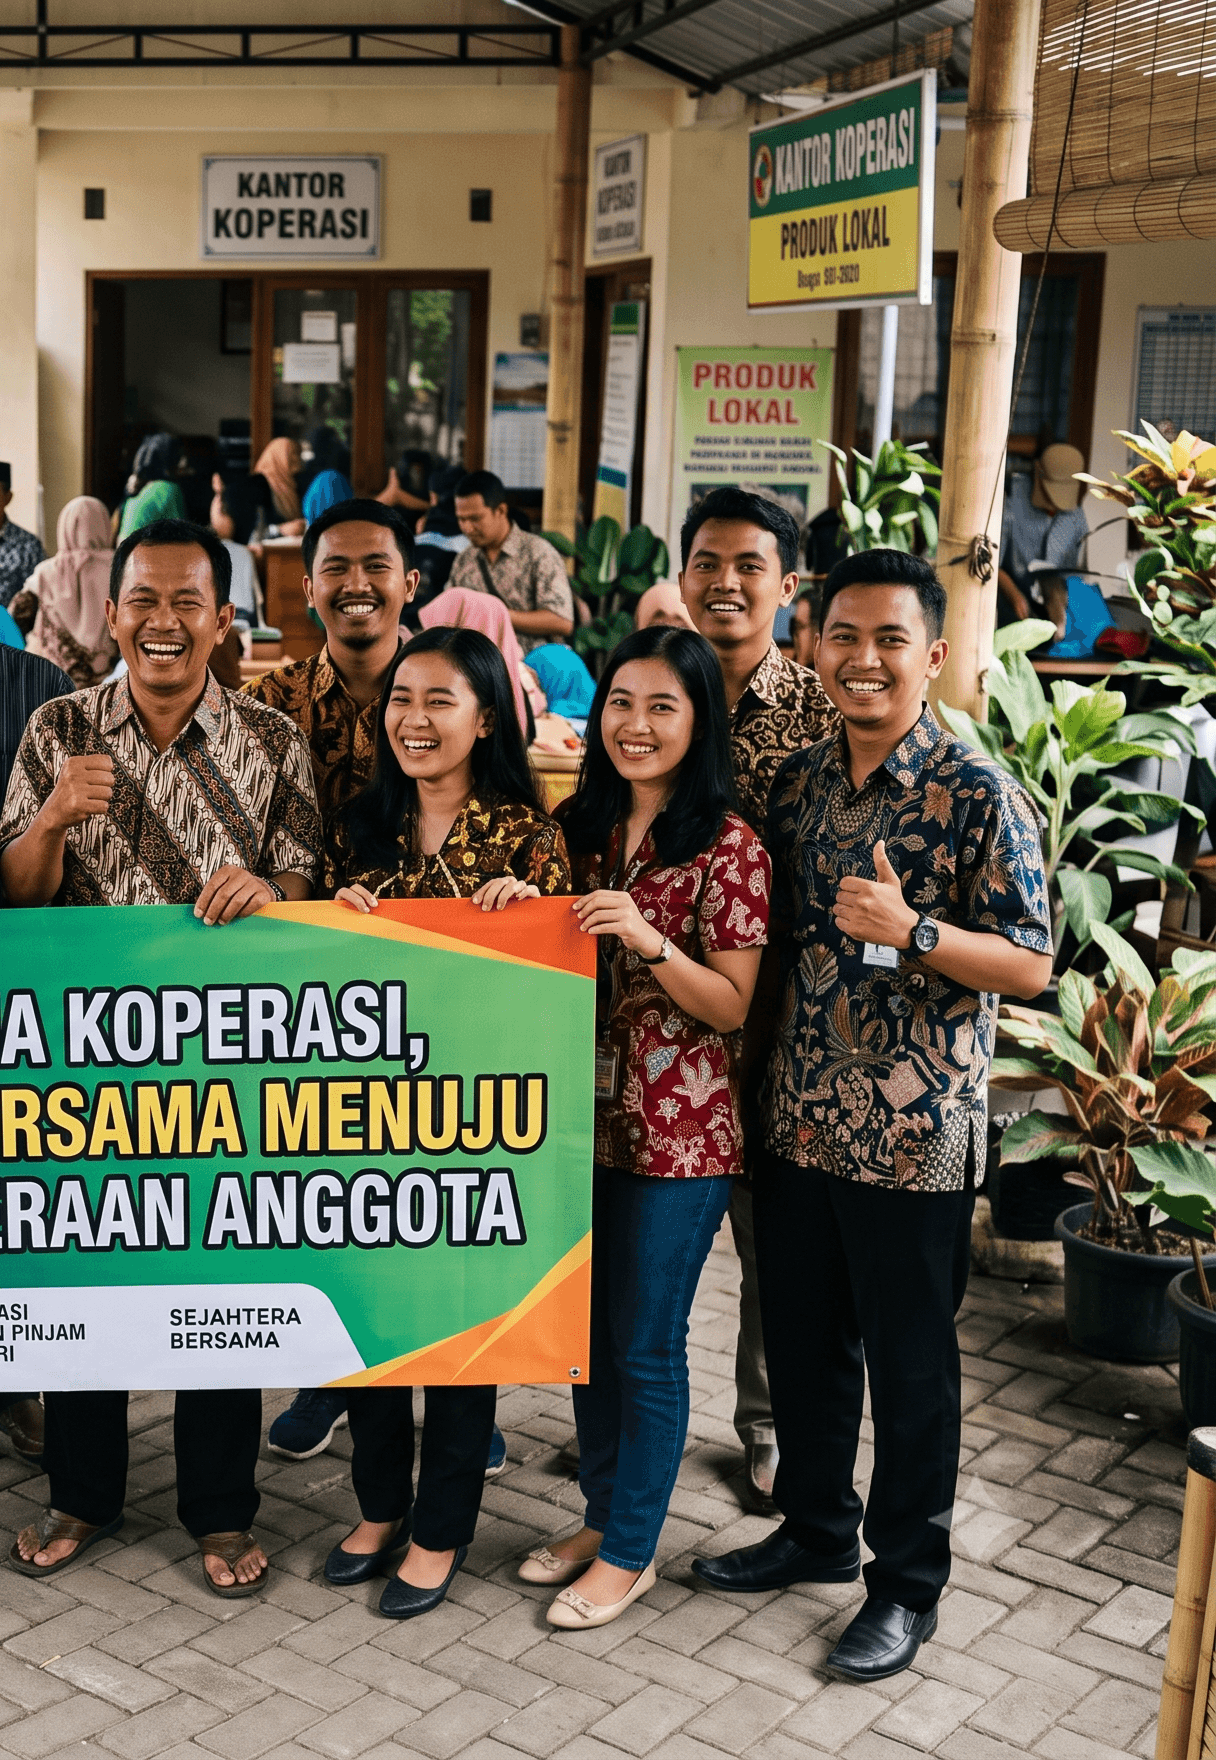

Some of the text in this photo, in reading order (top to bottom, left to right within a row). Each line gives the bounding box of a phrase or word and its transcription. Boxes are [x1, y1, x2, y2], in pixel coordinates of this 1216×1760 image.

[775, 107, 915, 196] KANTOR KOPERASI
[237, 172, 345, 198] KANTOR
[213, 208, 369, 239] KOPERASI
[780, 204, 890, 261] PRODUK LOKAL
[693, 362, 818, 390] PRODUK
[708, 398, 800, 425] LOKAL
[64, 980, 429, 1075] KOPERASI,
[260, 1073, 547, 1157] MENUJU
[202, 1167, 527, 1251] ANGGOTA
[169, 1307, 302, 1327] SEJAHTERA
[12, 1323, 86, 1341] PINJAM
[170, 1331, 280, 1350] BERSAMA
